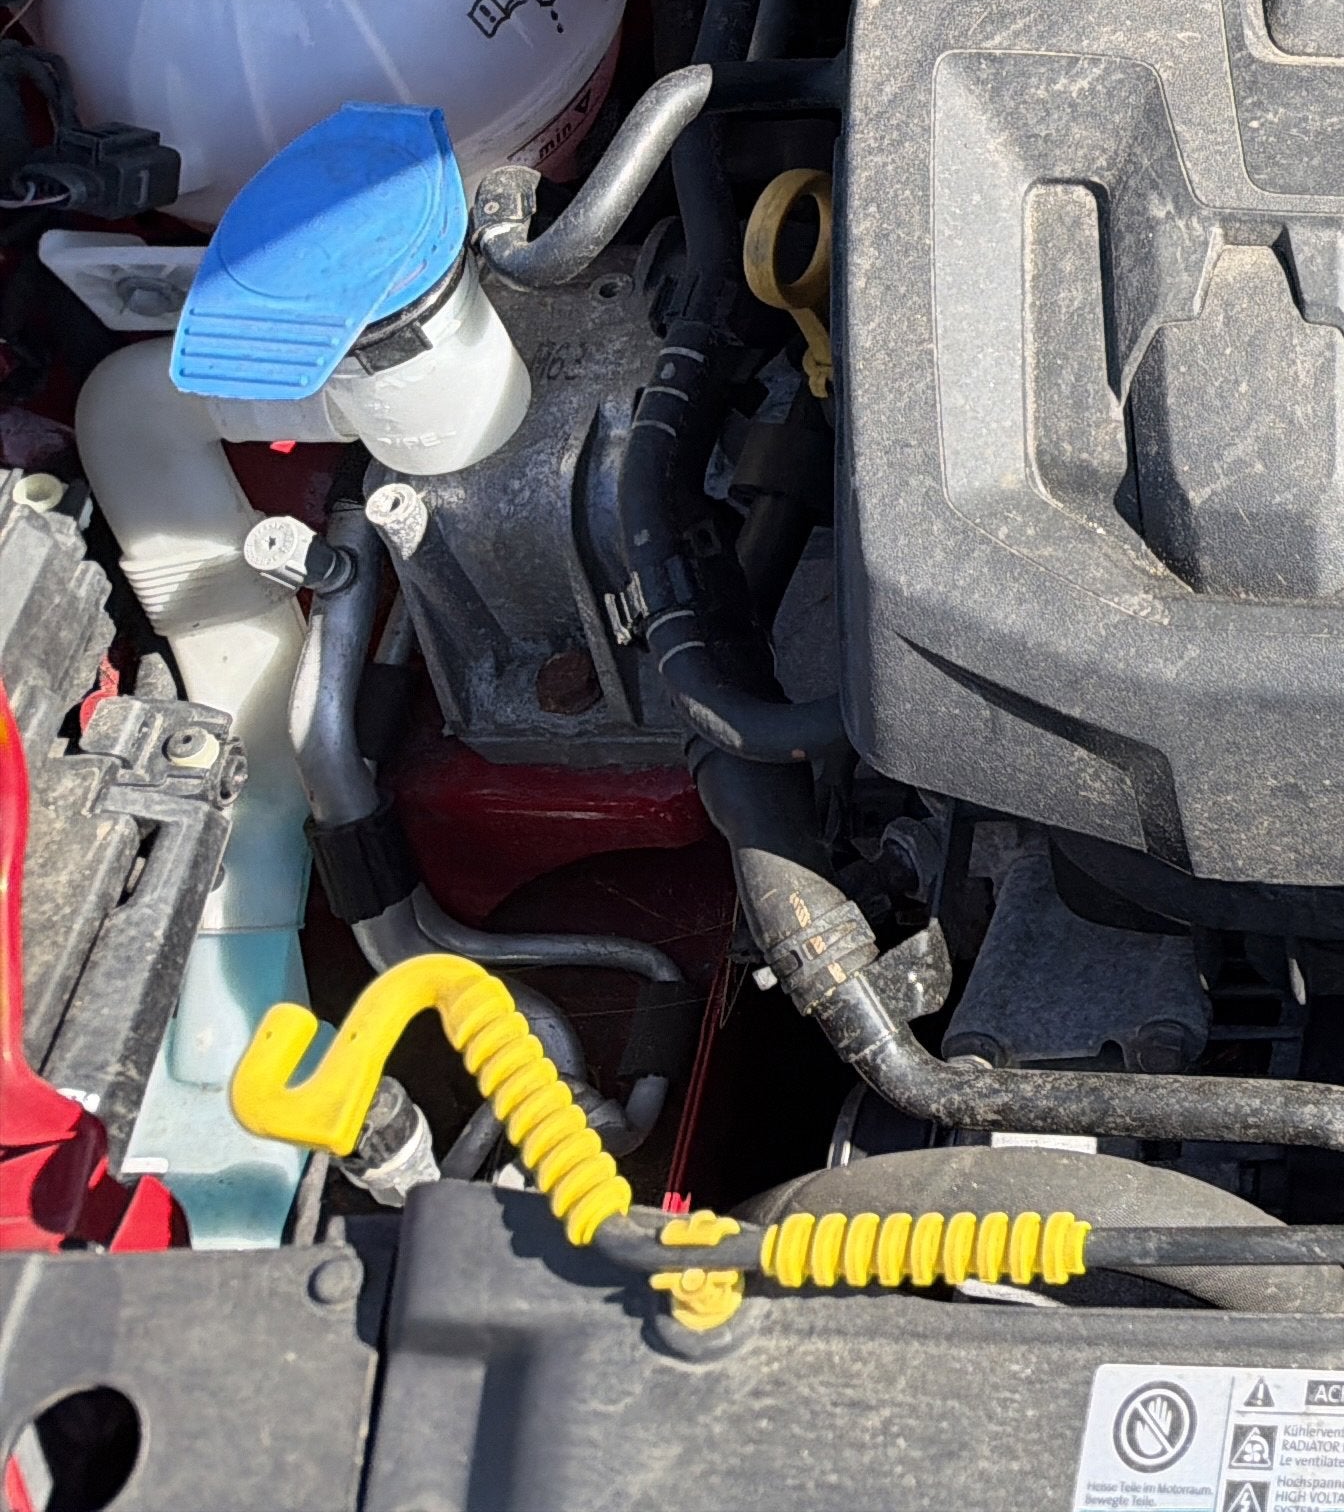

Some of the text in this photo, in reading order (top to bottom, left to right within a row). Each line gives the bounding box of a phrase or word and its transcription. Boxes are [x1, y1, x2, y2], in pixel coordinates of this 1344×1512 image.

[538, 121, 573, 160] min
[1281, 1440, 1339, 1453] RADIATOR
[1279, 1455, 1293, 1467] Le
[1120, 1481, 1142, 1493] Teile
[1143, 1483, 1156, 1494] im
[1276, 1491, 1306, 1504] HIGH
